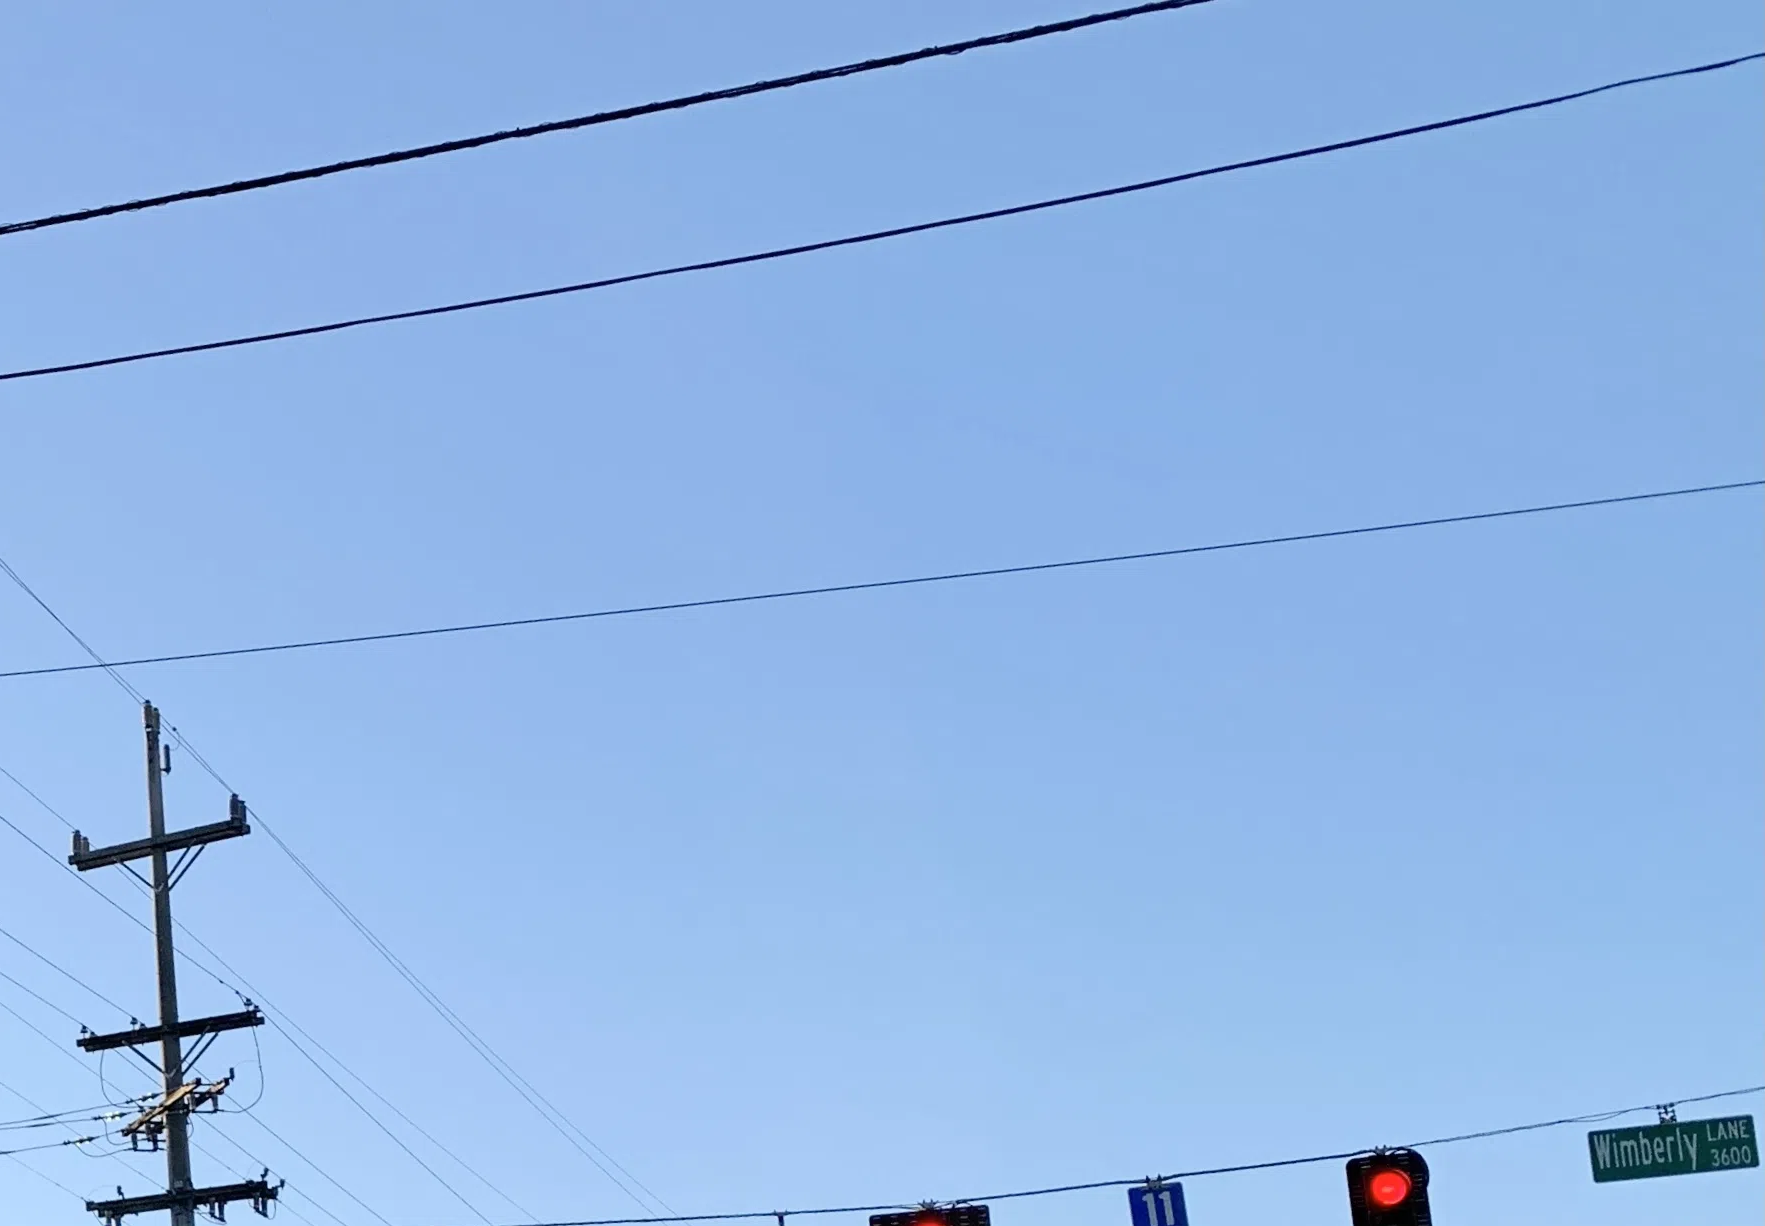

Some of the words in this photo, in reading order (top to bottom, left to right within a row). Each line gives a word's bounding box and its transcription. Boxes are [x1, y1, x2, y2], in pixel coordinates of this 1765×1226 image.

[1706, 1119, 1749, 1142] LANE
[1594, 1127, 1698, 1171] Wimberly
[1710, 1145, 1752, 1167] 3600
